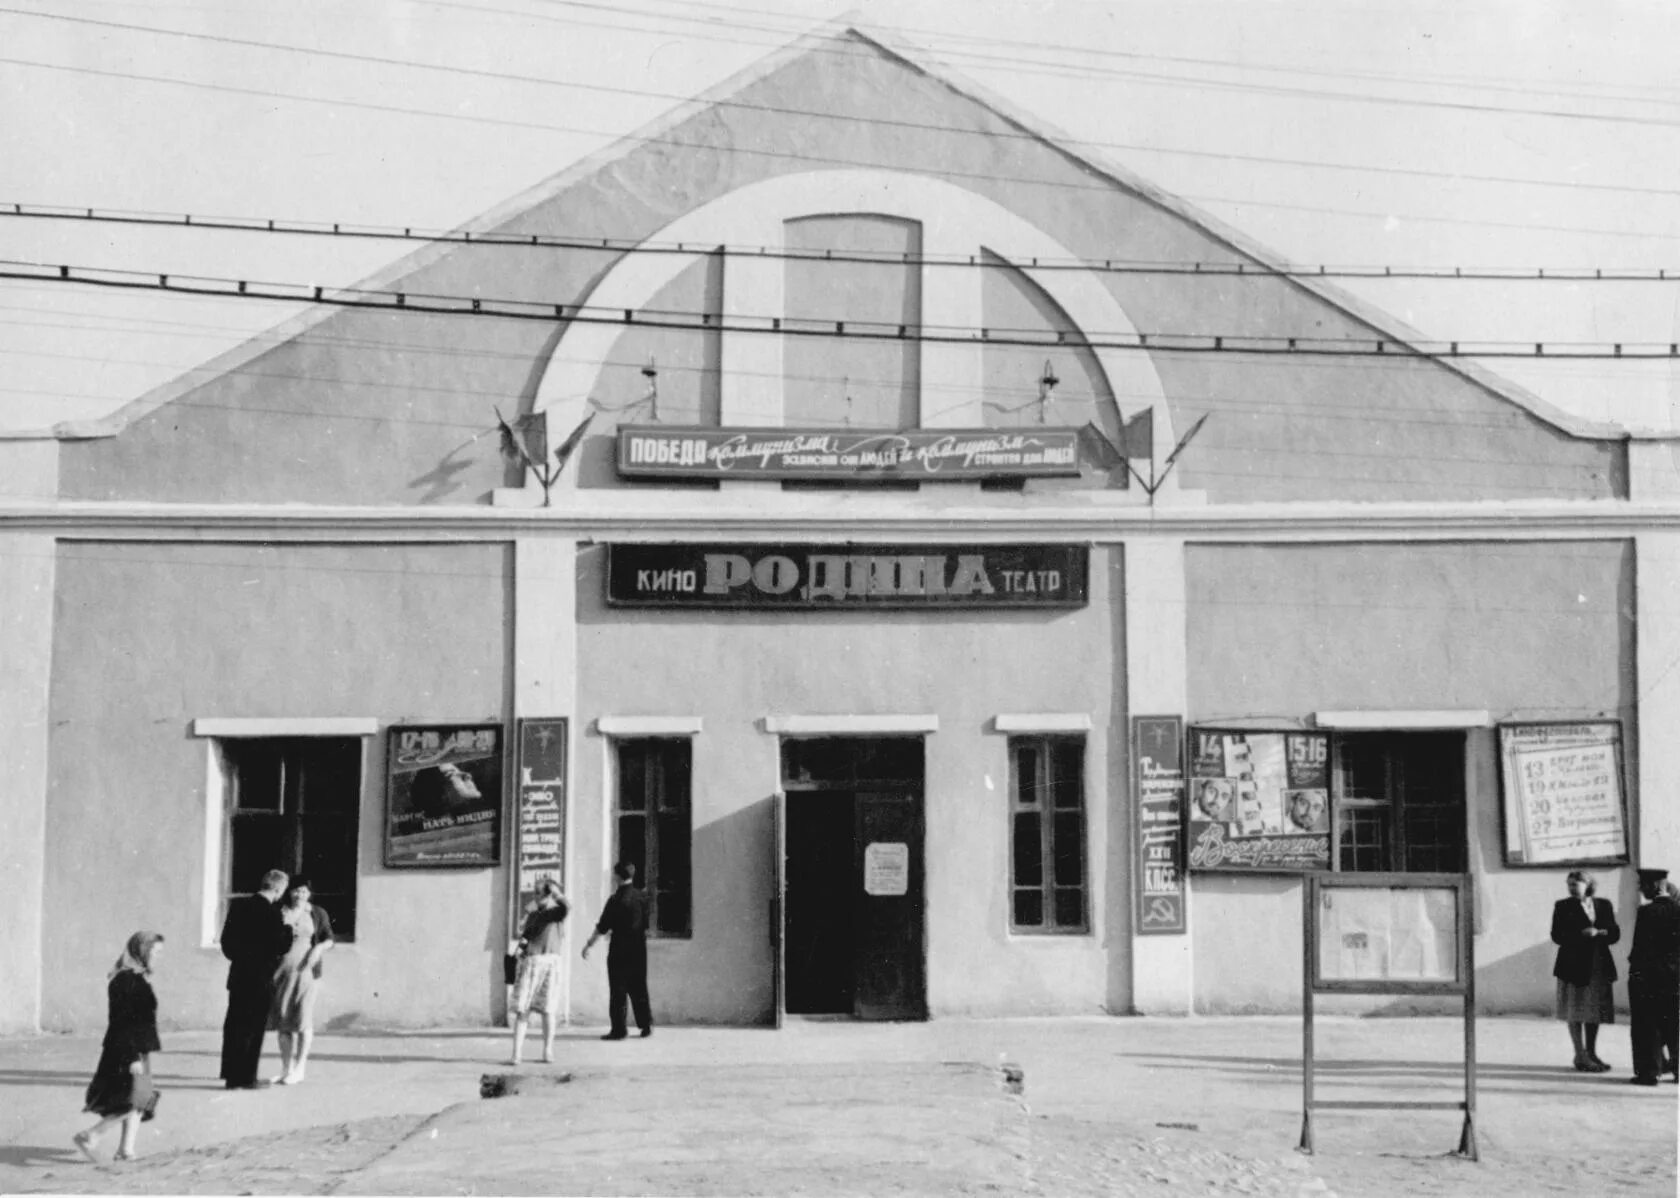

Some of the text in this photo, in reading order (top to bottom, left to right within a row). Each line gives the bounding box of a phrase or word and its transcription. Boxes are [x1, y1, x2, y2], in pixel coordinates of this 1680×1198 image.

[630, 438, 707, 466] ПОБЕДА
[637, 553, 1060, 600] КИНО РОДИНА ТЕАТР
